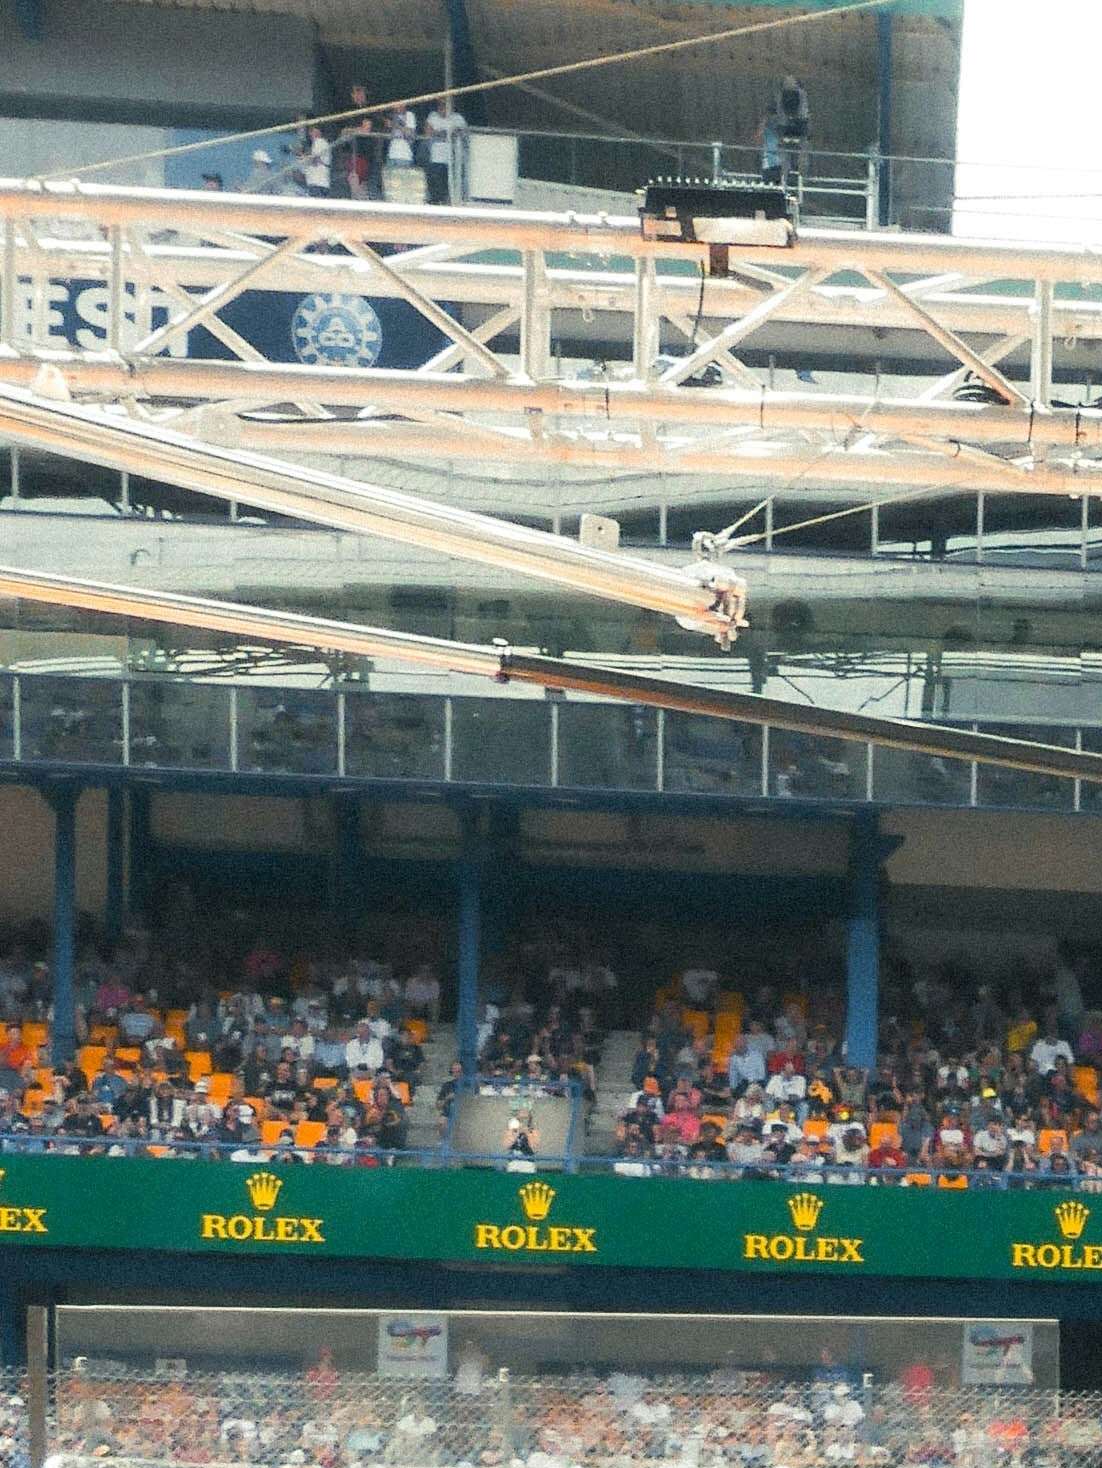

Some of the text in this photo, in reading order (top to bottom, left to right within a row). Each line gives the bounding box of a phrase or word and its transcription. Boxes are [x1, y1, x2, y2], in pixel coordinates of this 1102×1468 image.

[202, 1214, 325, 1242] ROLEX
[475, 1224, 597, 1252] ROLEX
[743, 1234, 864, 1262] ROLEX
